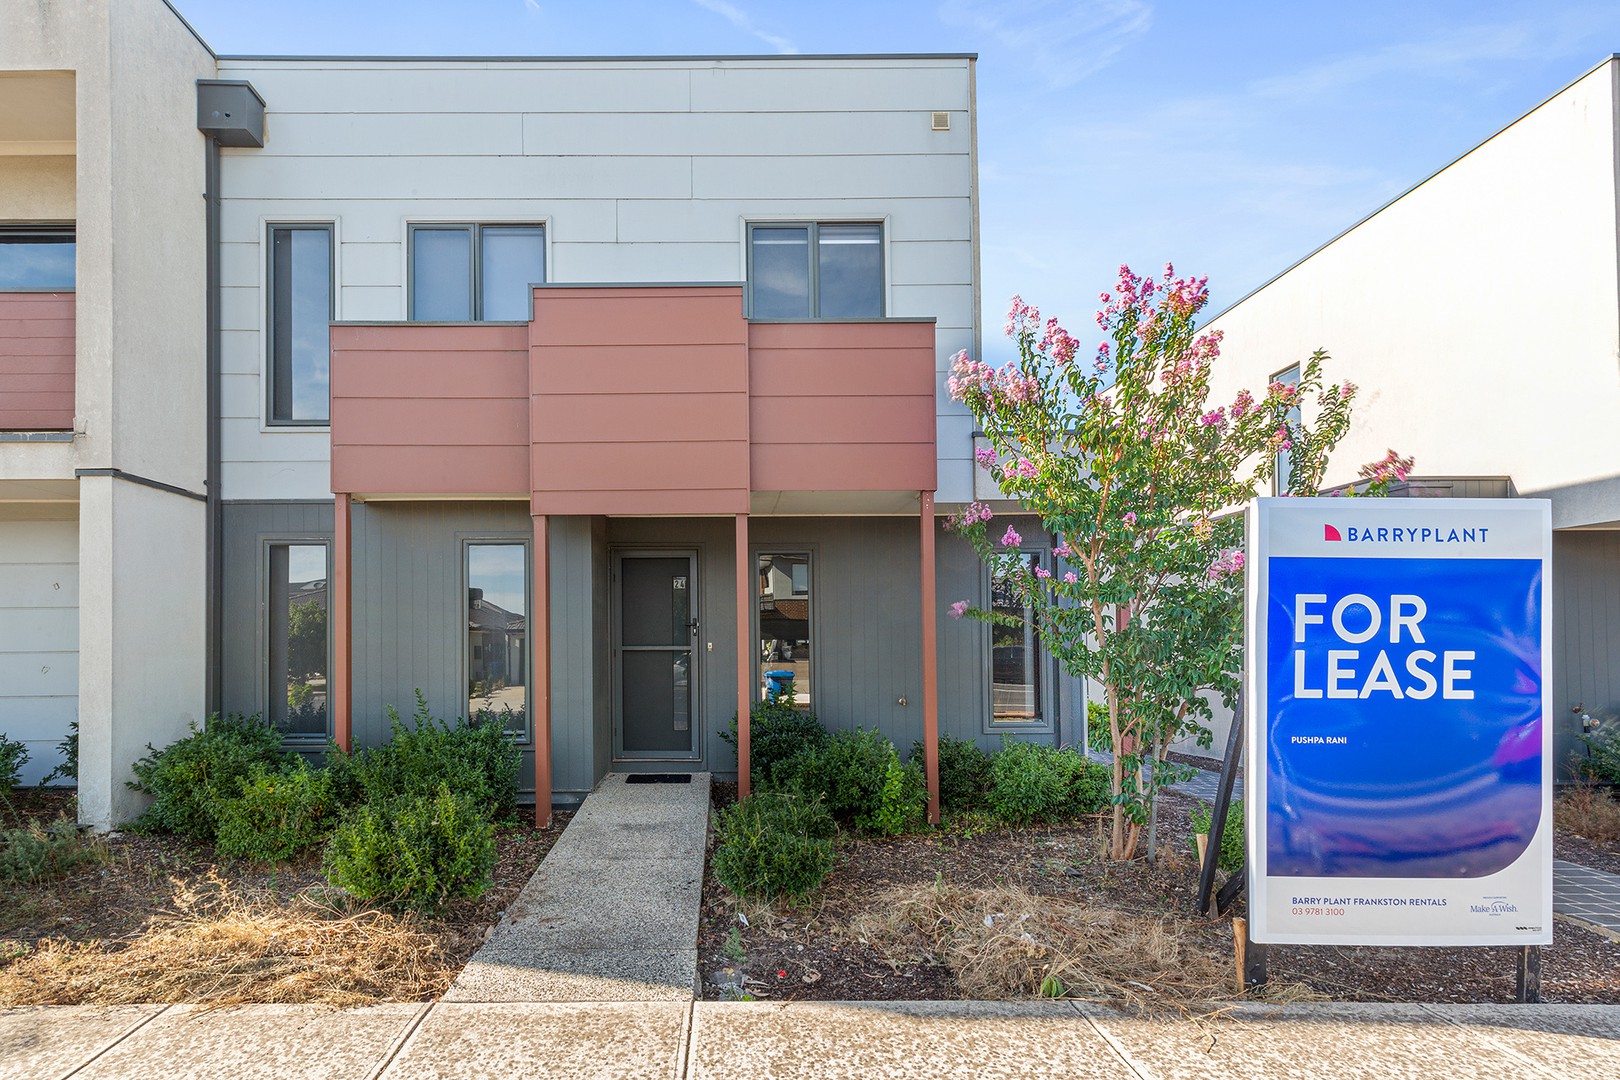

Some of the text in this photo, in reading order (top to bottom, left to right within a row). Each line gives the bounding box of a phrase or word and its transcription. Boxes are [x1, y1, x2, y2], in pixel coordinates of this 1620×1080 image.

[1348, 527, 1489, 543] BARRYPLANT
[1295, 593, 1427, 644] FOR
[1294, 649, 1476, 700] LEASE
[1291, 736, 1347, 744] PUSHPA RANI
[1292, 897, 1447, 907] BARRY PLANT FRANKSTON RENTALS
[1292, 907, 1345, 916] 03 9781 3100
